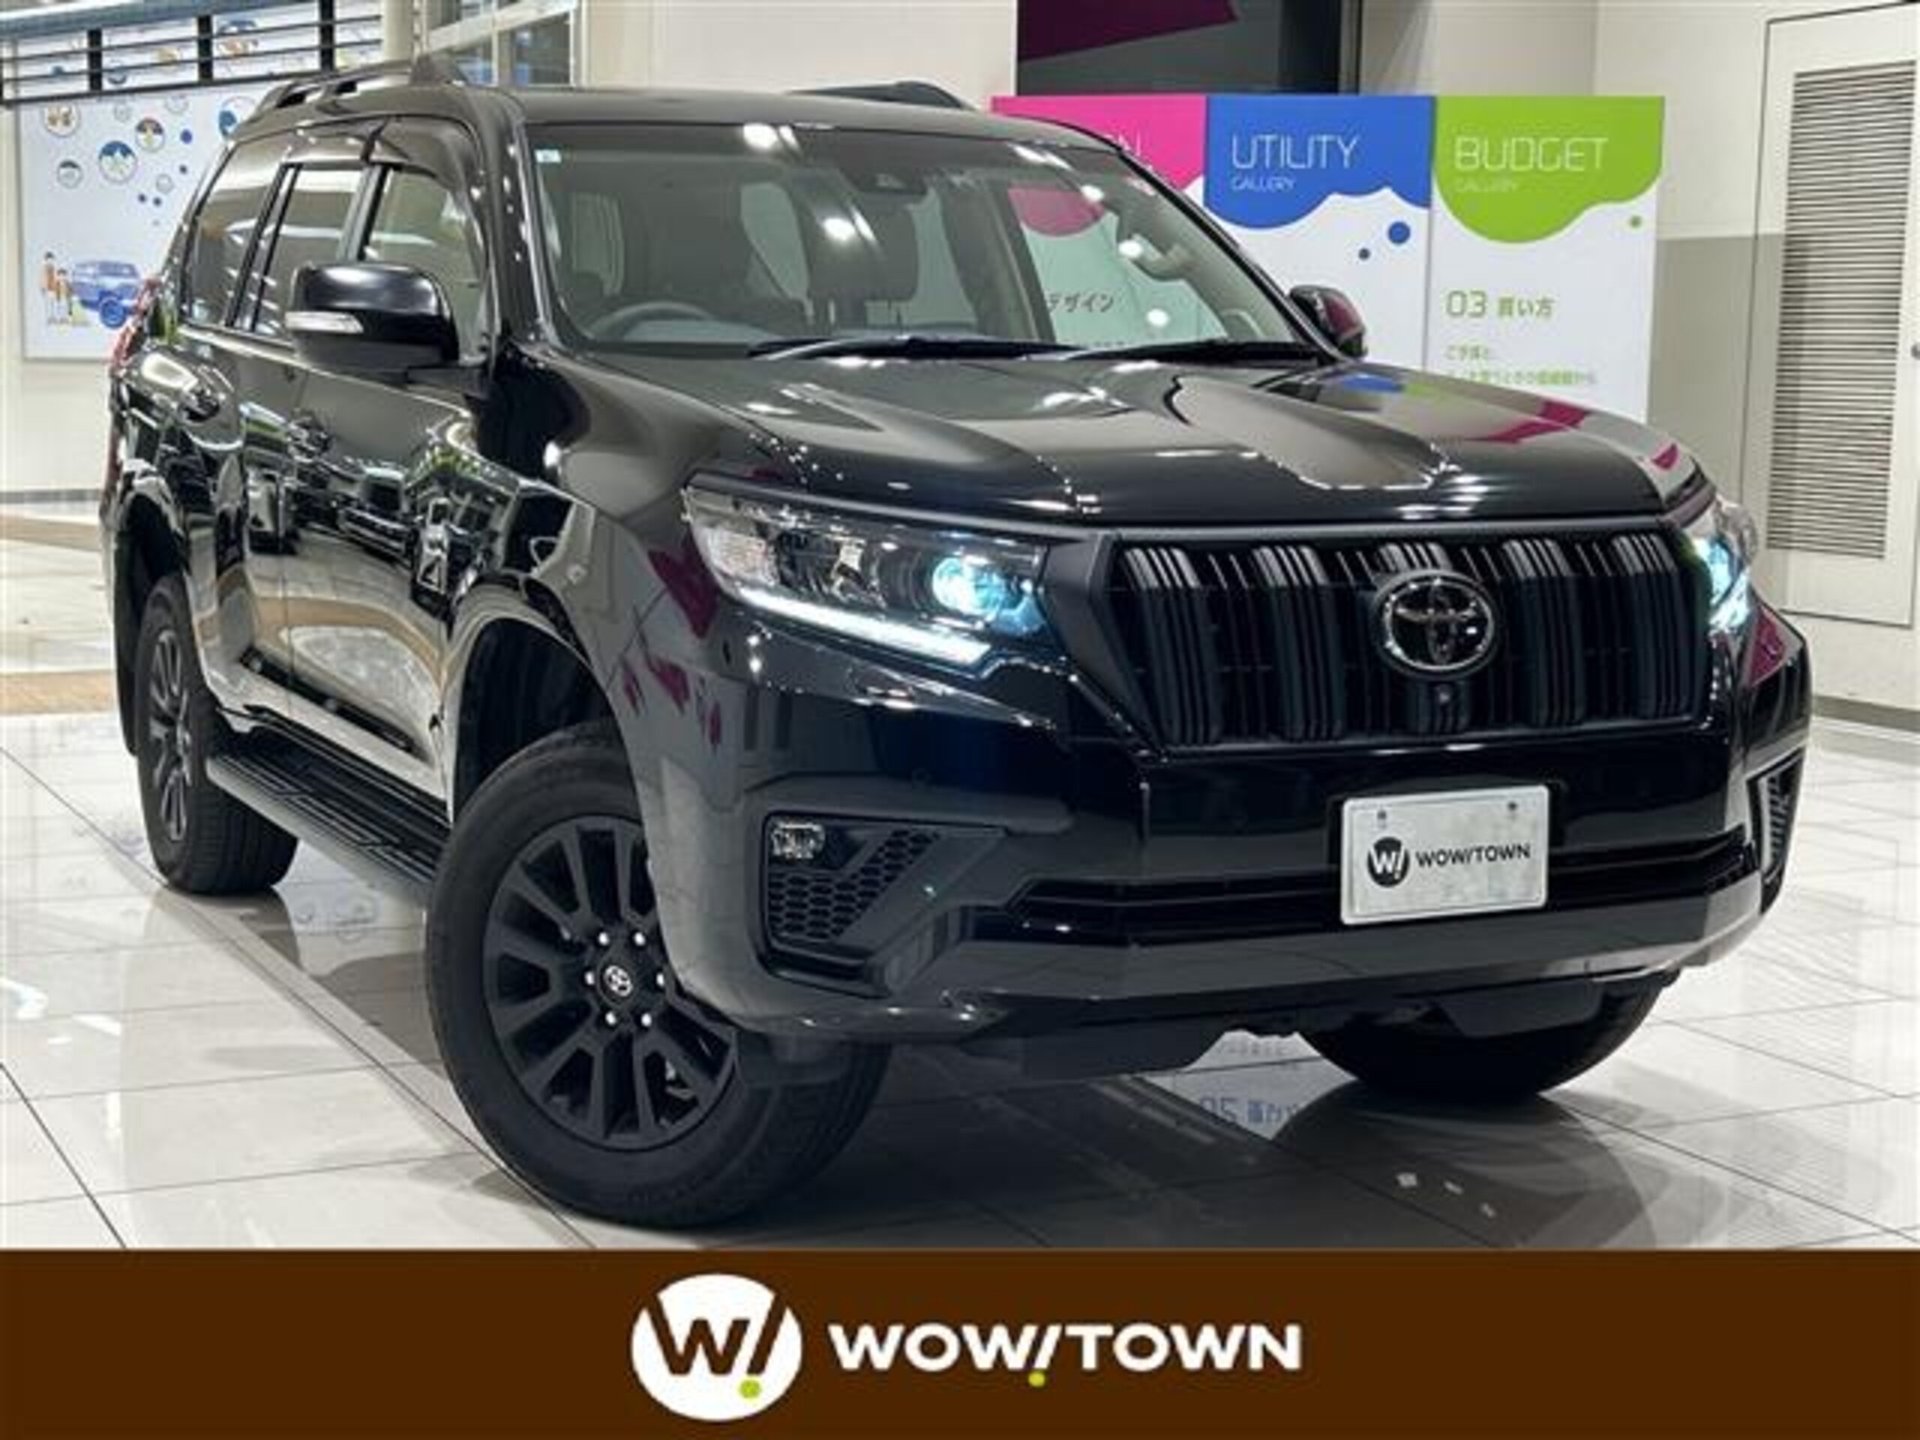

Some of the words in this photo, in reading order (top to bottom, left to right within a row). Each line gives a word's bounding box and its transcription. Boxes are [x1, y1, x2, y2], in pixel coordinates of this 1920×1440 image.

[1231, 133, 1360, 169] UTILITY
[1454, 135, 1609, 172] BUDGET
[1446, 289, 1487, 318] 03
